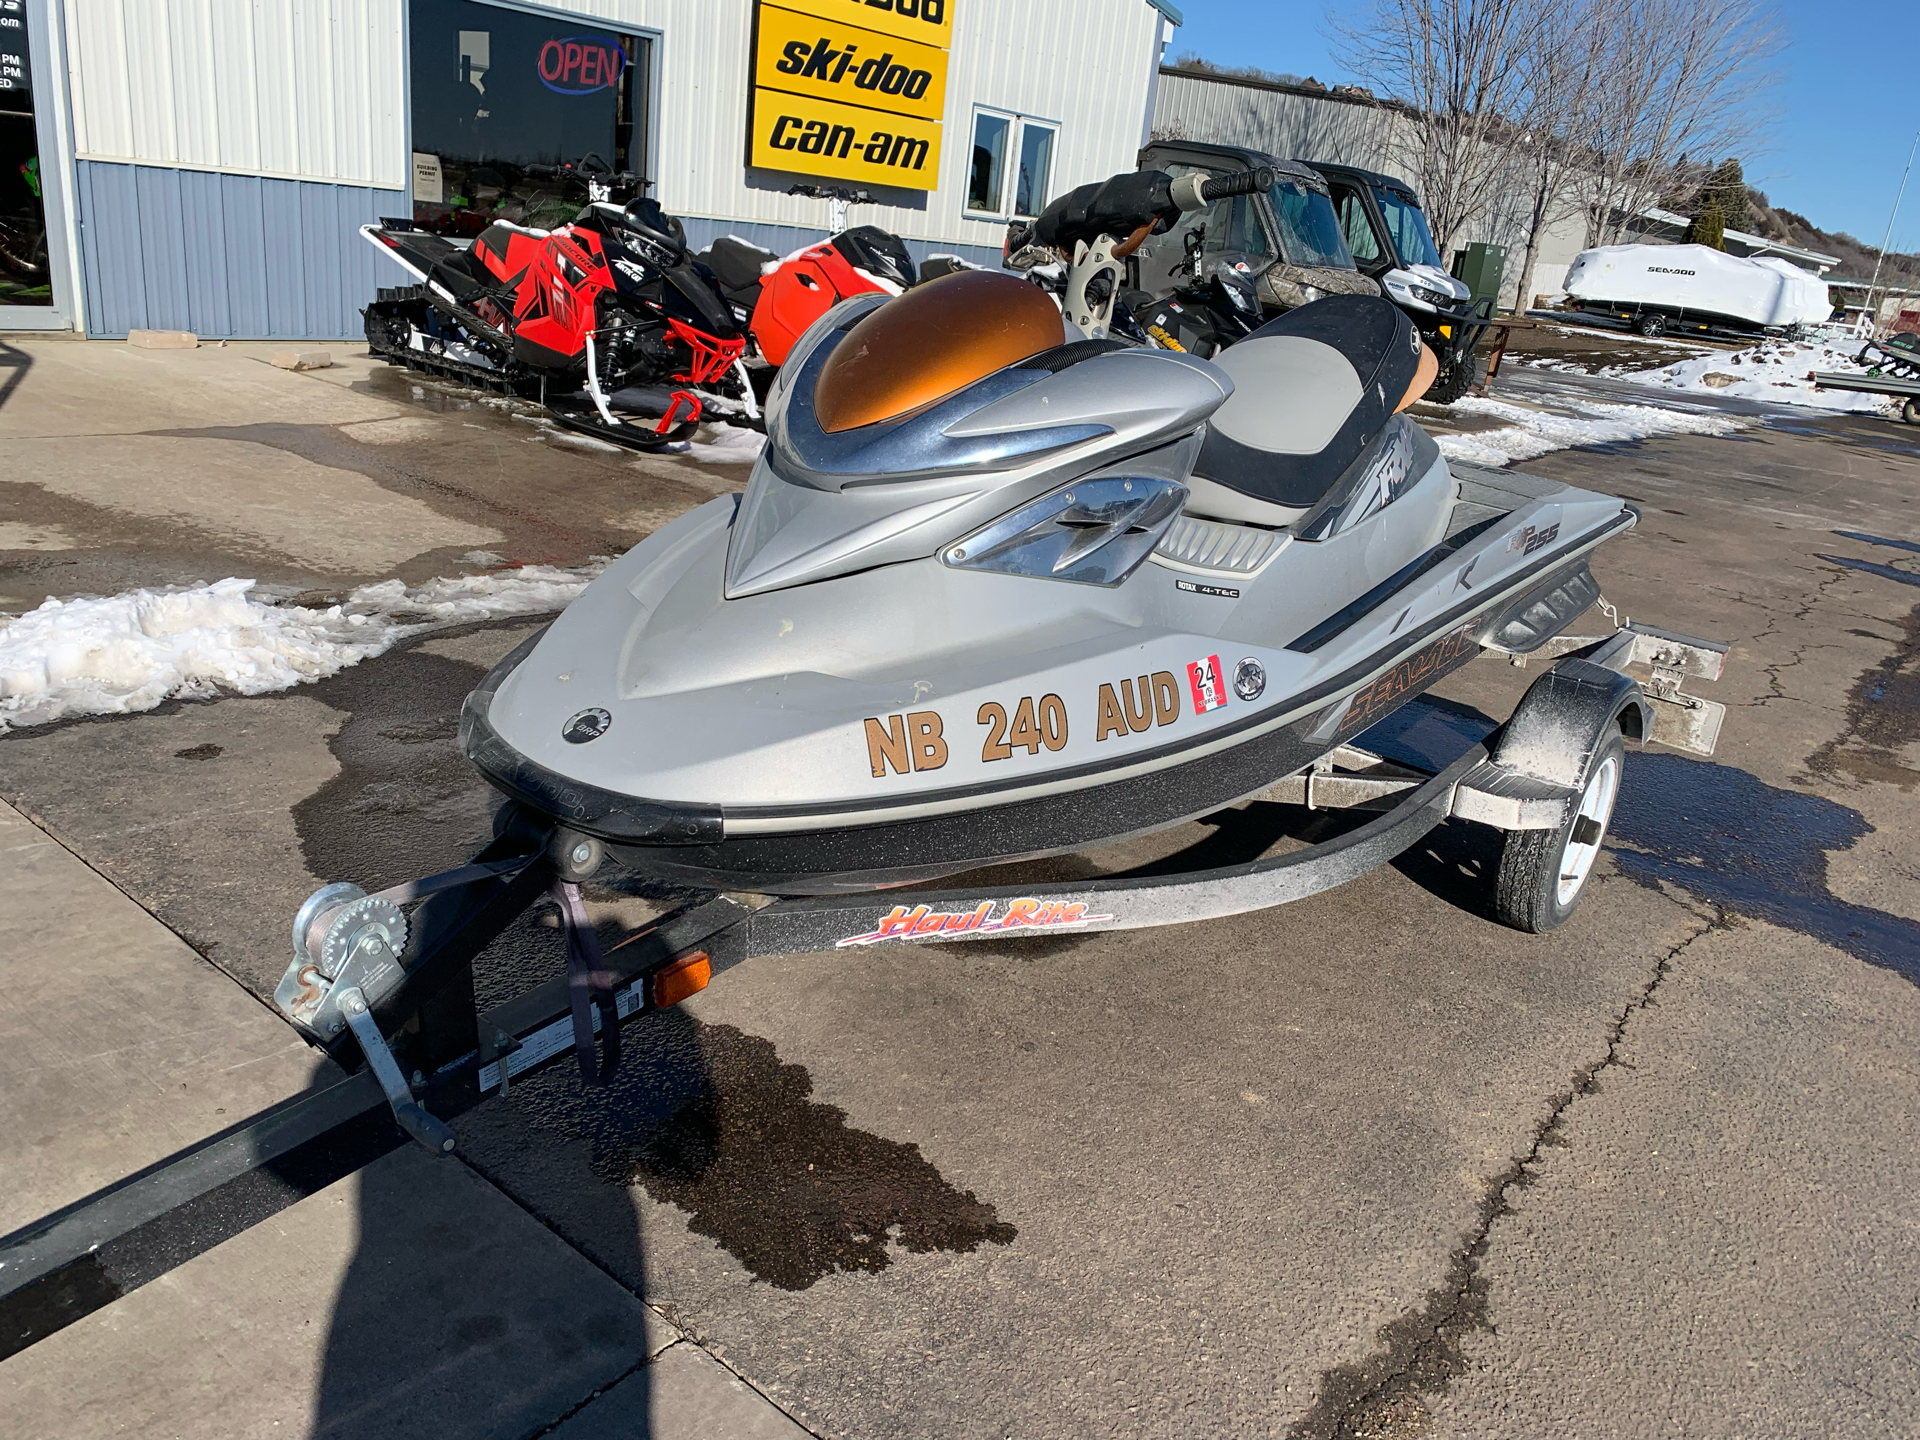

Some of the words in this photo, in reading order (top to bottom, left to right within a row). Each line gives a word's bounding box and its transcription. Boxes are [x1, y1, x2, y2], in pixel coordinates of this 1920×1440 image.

[2, 53, 20, 65] PM
[3, 66, 21, 77] PM
[539, 40, 619, 87] OPEN
[776, 37, 932, 100] ski-doo
[769, 115, 930, 170] can-am
[416, 164, 438, 172] BUILDING
[1523, 522, 1560, 557] 255
[1177, 581, 1197, 592] ROTAX
[1201, 586, 1238, 597] 4-TEC
[1194, 662, 1216, 690] 24
[576, 725, 600, 736] BRP
[863, 711, 949, 778] NB
[977, 693, 1069, 763] 240
[1096, 670, 1181, 742] AUD
[879, 903, 995, 936] Haul
[1002, 898, 1088, 928] Rite
